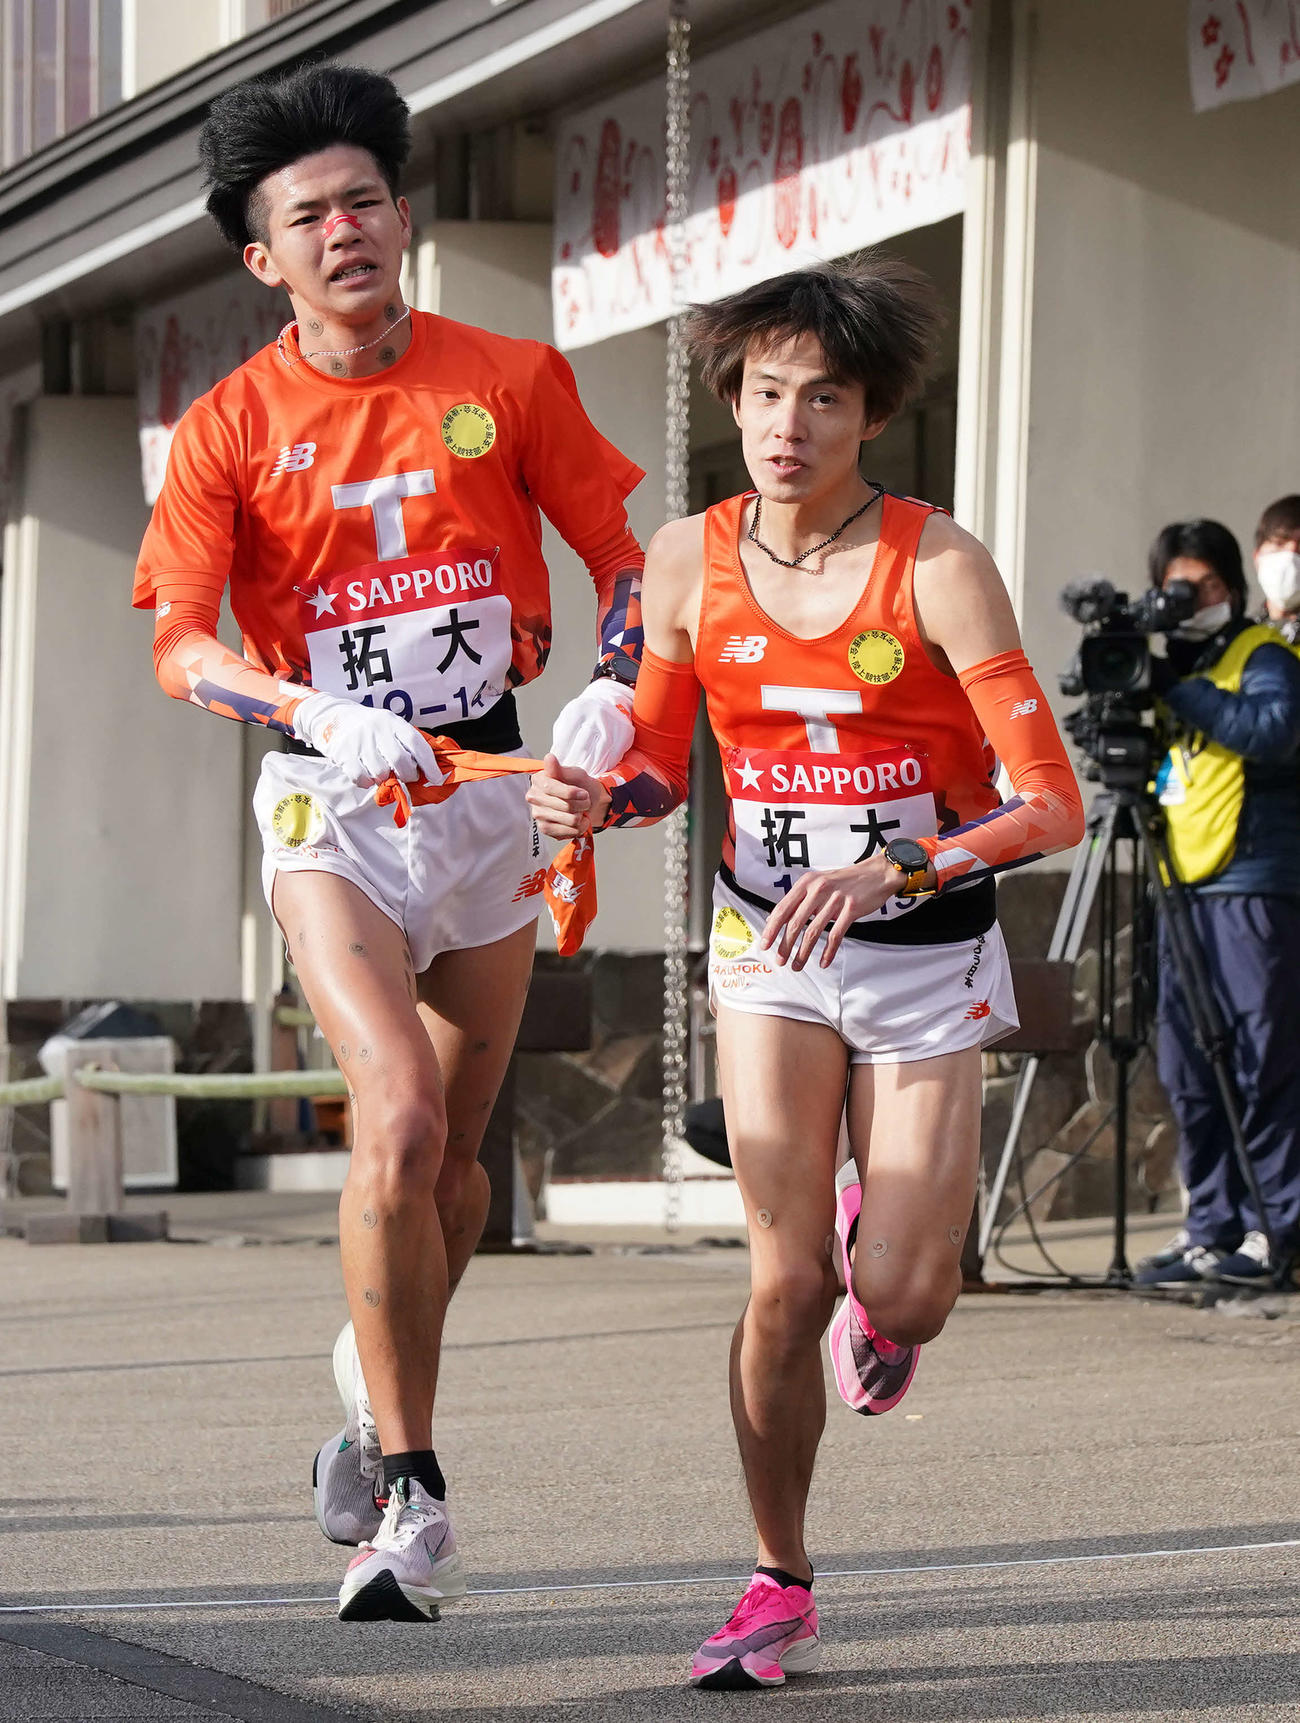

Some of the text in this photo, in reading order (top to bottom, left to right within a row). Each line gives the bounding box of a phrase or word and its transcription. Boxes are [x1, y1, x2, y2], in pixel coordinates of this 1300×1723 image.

[330, 468, 437, 562] T
[345, 558, 493, 612] SAPPORO
[760, 684, 864, 754] T
[770, 757, 922, 795] SAPPORO
